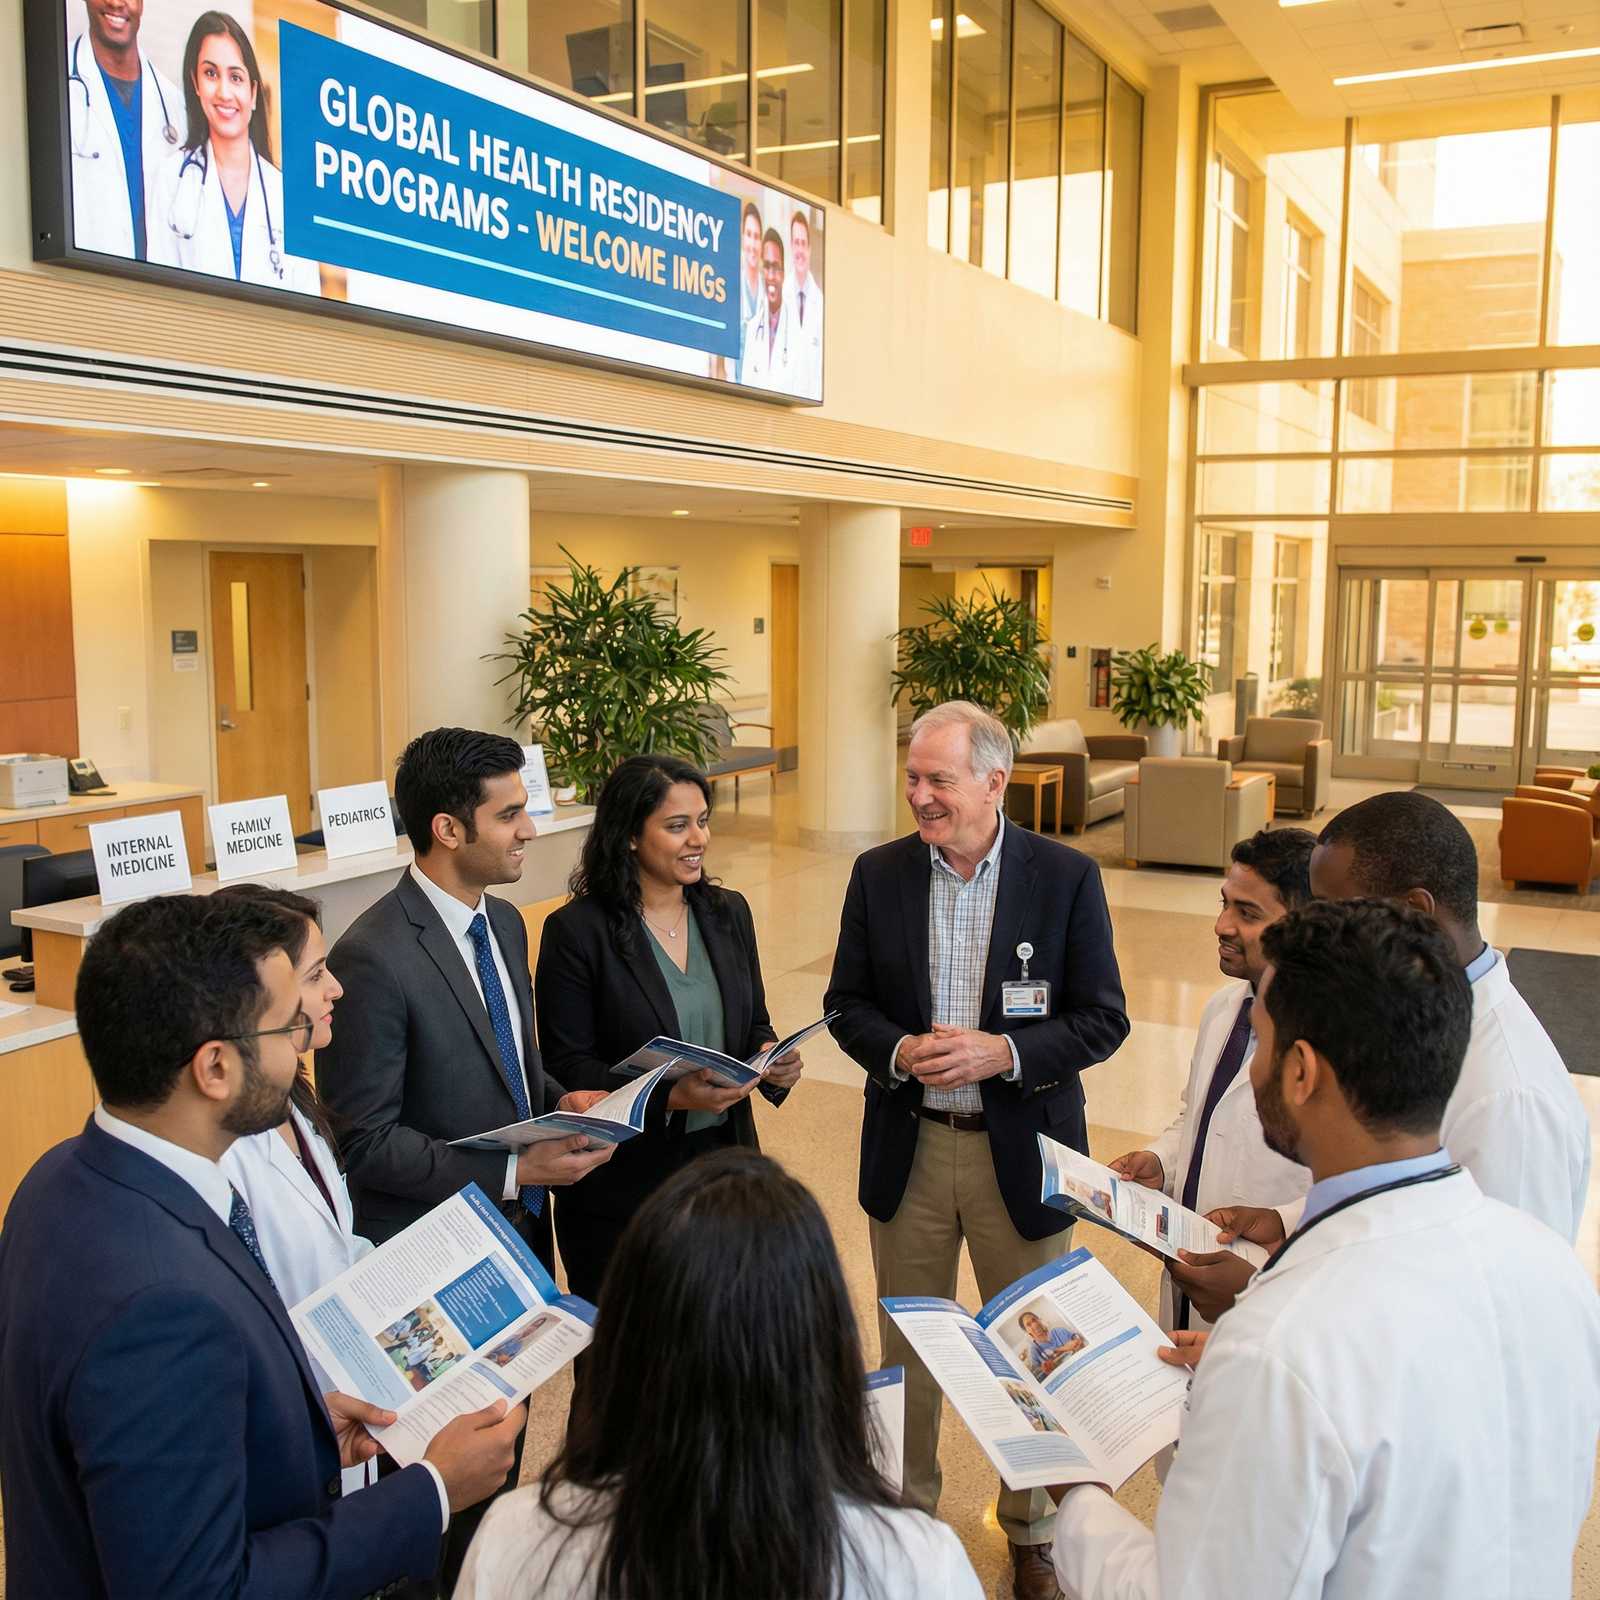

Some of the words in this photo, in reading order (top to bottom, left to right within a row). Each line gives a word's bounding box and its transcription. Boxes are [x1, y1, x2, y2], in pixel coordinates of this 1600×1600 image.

[319, 77, 460, 166] GLOBAL
[469, 129, 582, 207] HEALTH
[590, 172, 724, 253] RESIDENCY
[315, 140, 510, 240] PROGRAMS
[517, 223, 529, 234] -
[535, 210, 667, 286] WELCOME
[673, 254, 727, 303] IMGs
[231, 816, 272, 836] FAMILY
[328, 806, 386, 828] PEDIATRICS
[106, 834, 173, 858] INTERNAL
[226, 833, 283, 855] MEDICINE
[110, 853, 176, 878] MEDICINE
